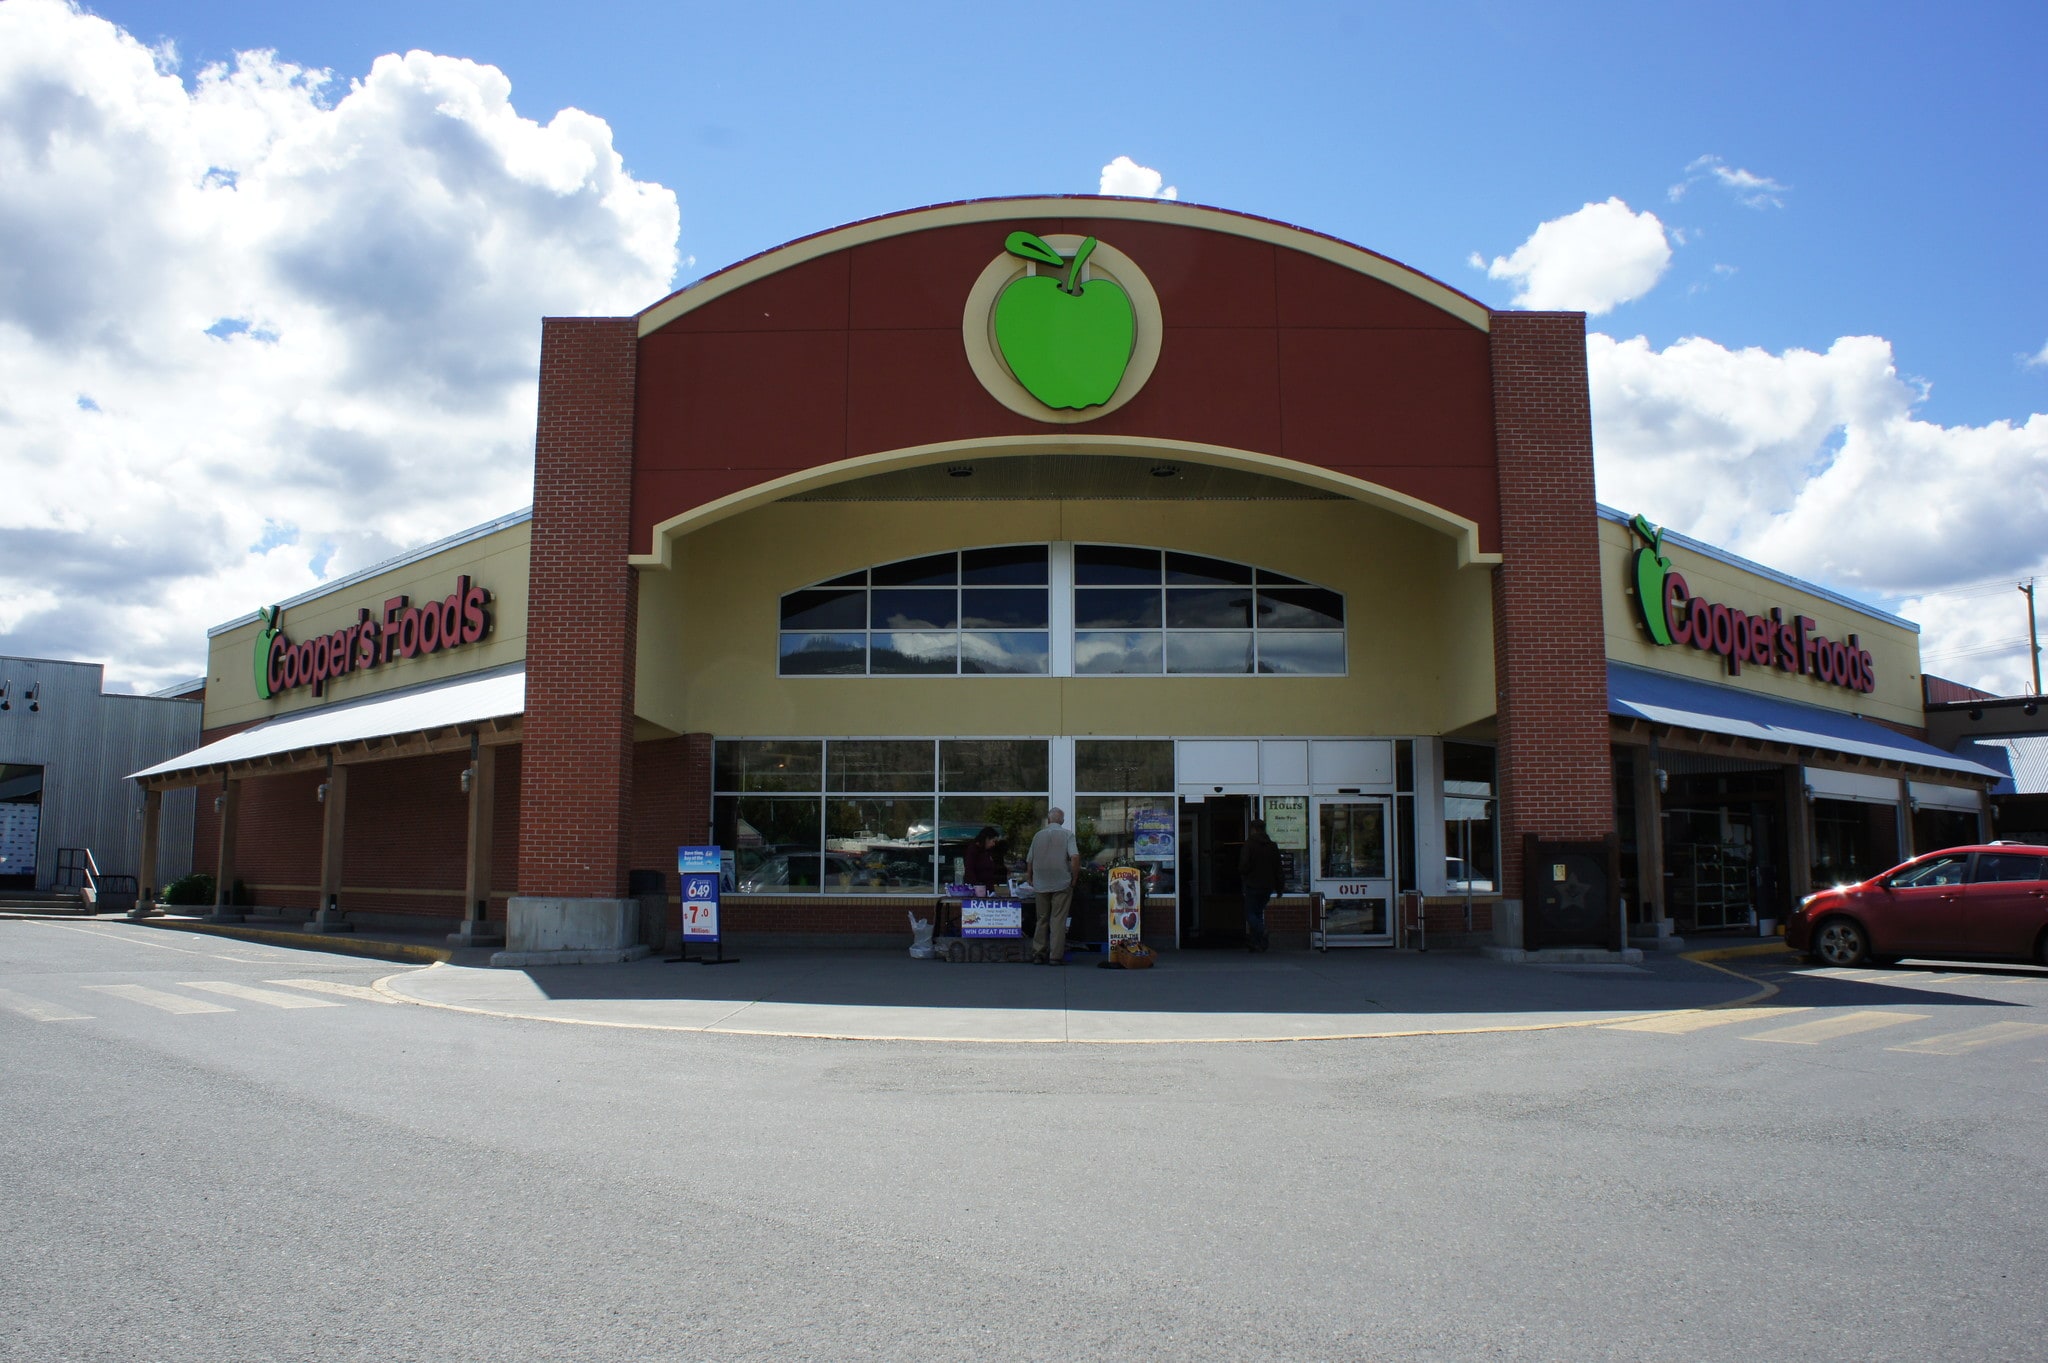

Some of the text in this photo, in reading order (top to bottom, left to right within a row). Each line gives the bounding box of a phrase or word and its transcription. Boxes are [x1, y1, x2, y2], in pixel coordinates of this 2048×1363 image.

[267, 574, 491, 697] Cooper's Foods
[1664, 572, 1875, 693] Cooper's Foods
[1269, 800, 1302, 810] Hours
[1339, 885, 1367, 895] OUT
[971, 900, 1013, 908] RAFFLE
